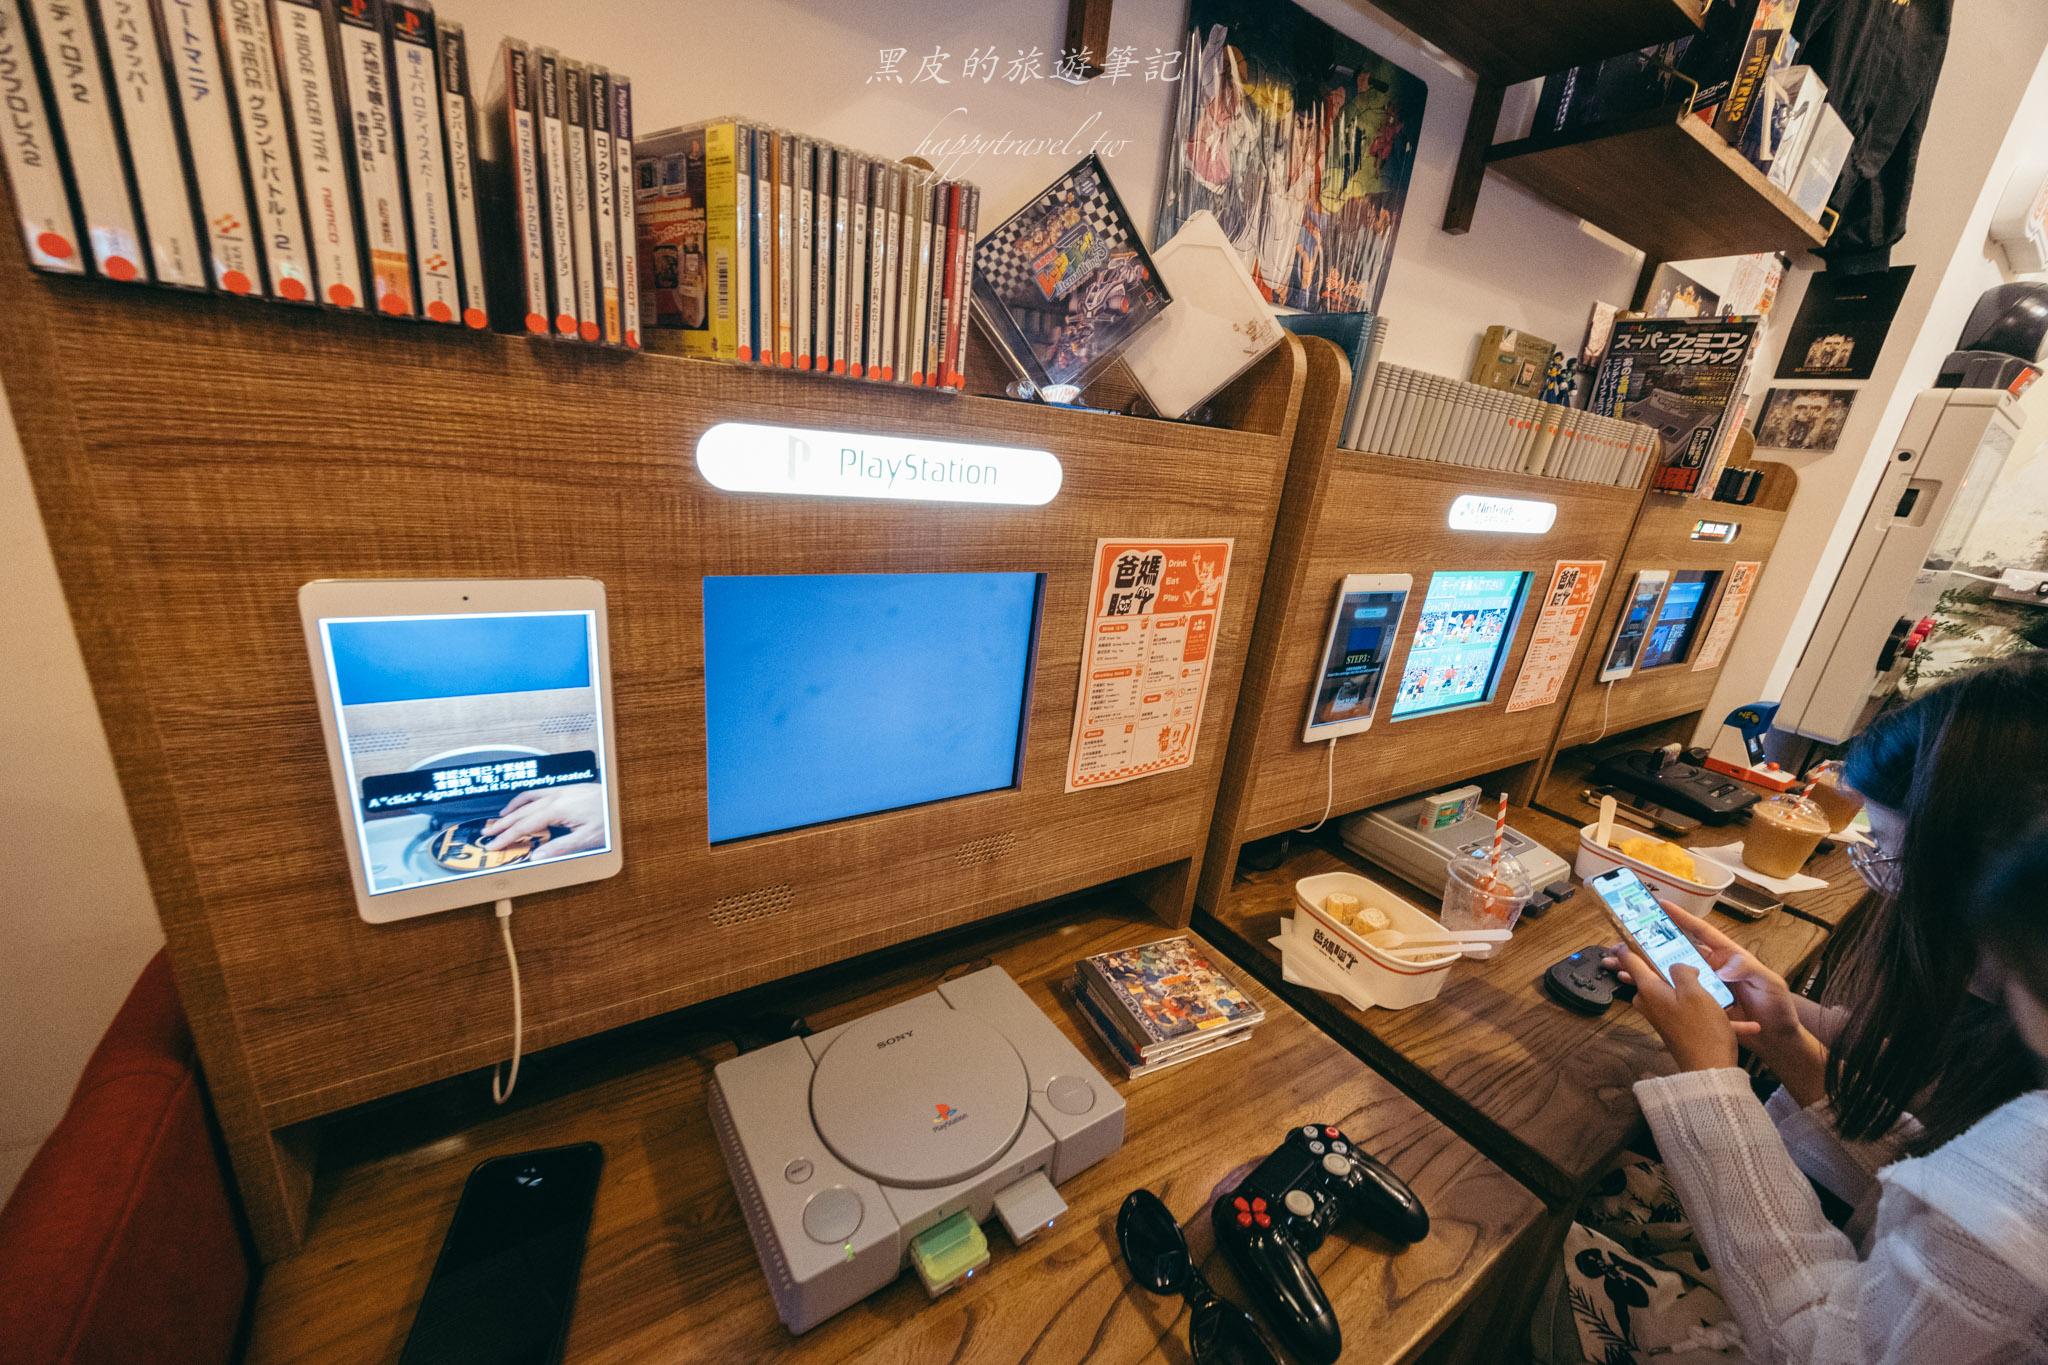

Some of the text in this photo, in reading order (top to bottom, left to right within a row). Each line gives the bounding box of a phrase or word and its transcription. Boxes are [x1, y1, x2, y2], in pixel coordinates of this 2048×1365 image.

[233, 0, 253, 31] ONE
[239, 38, 263, 92] PIECE
[294, 35, 316, 77] RIDGE
[513, 53, 528, 106] PlayStation
[543, 62, 557, 117] PlayStation
[567, 72, 579, 124] PlayStation
[303, 79, 323, 127] RACER
[593, 78, 605, 129] PlayStation
[616, 89, 629, 138] PlayStation
[310, 130, 330, 163] TYPE
[322, 187, 340, 244] namco
[1615, 332, 1748, 349] スーパーファミコン
[1659, 349, 1743, 364] クラシック
[840, 447, 998, 488] PlayStation
[1114, 555, 1163, 588] 爸媽
[1165, 576, 1180, 586] Eat
[1168, 558, 1187, 568] Drink
[1162, 594, 1180, 603] Play
[422, 787, 464, 802] signals
[464, 784, 490, 797] that
[510, 775, 556, 793] properly
[555, 770, 594, 784] seated.
[876, 1030, 914, 1050] SONY
